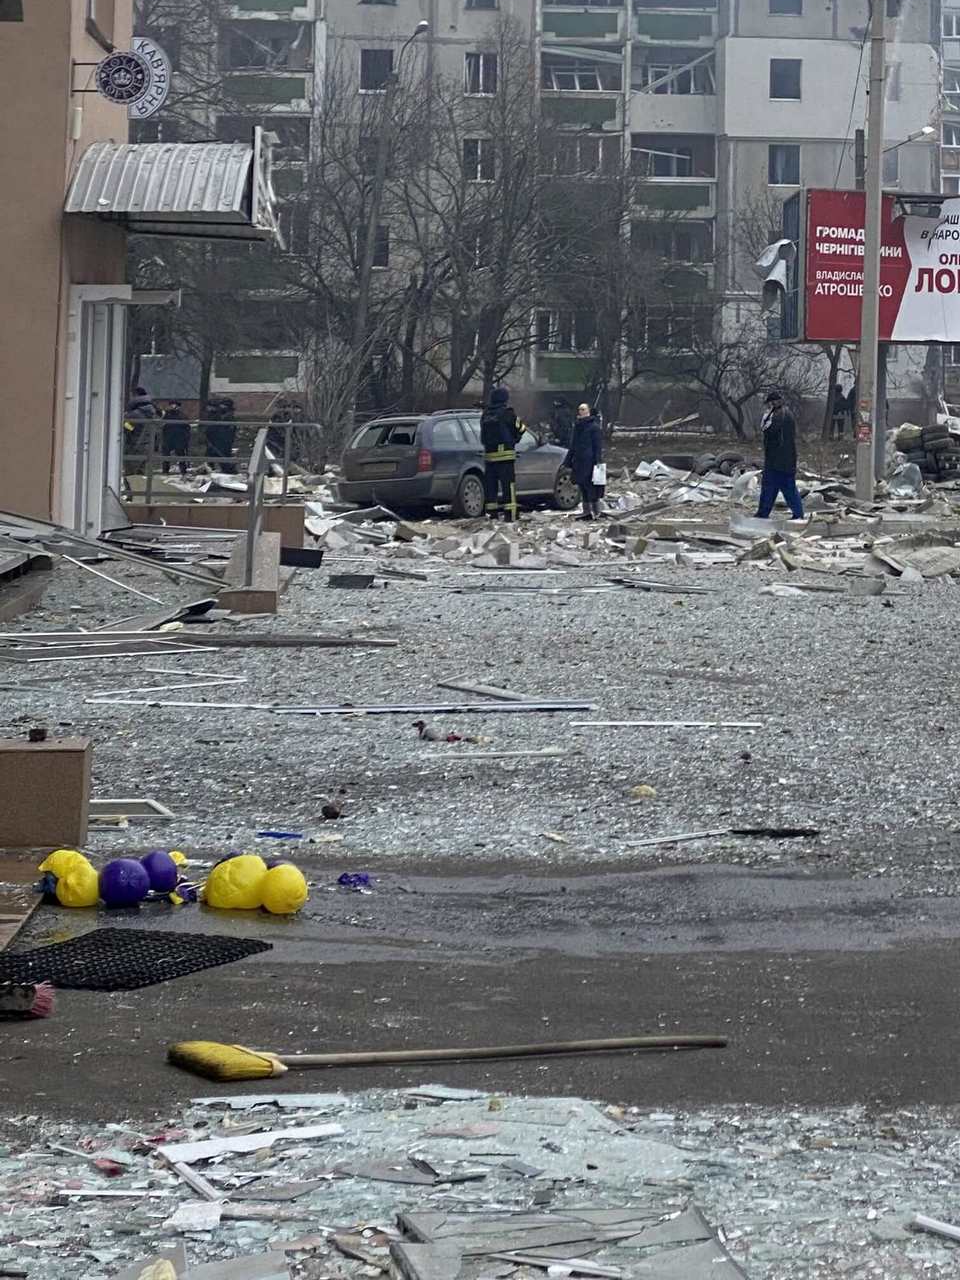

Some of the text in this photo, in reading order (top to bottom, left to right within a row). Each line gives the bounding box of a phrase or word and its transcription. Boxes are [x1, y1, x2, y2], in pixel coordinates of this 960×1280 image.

[136, 40, 166, 115] КАВ'ЯРНЯ
[815, 242, 902, 257] ЧЕРНІГІВИНИ
[815, 283, 892, 297] АТРОШЕКО
